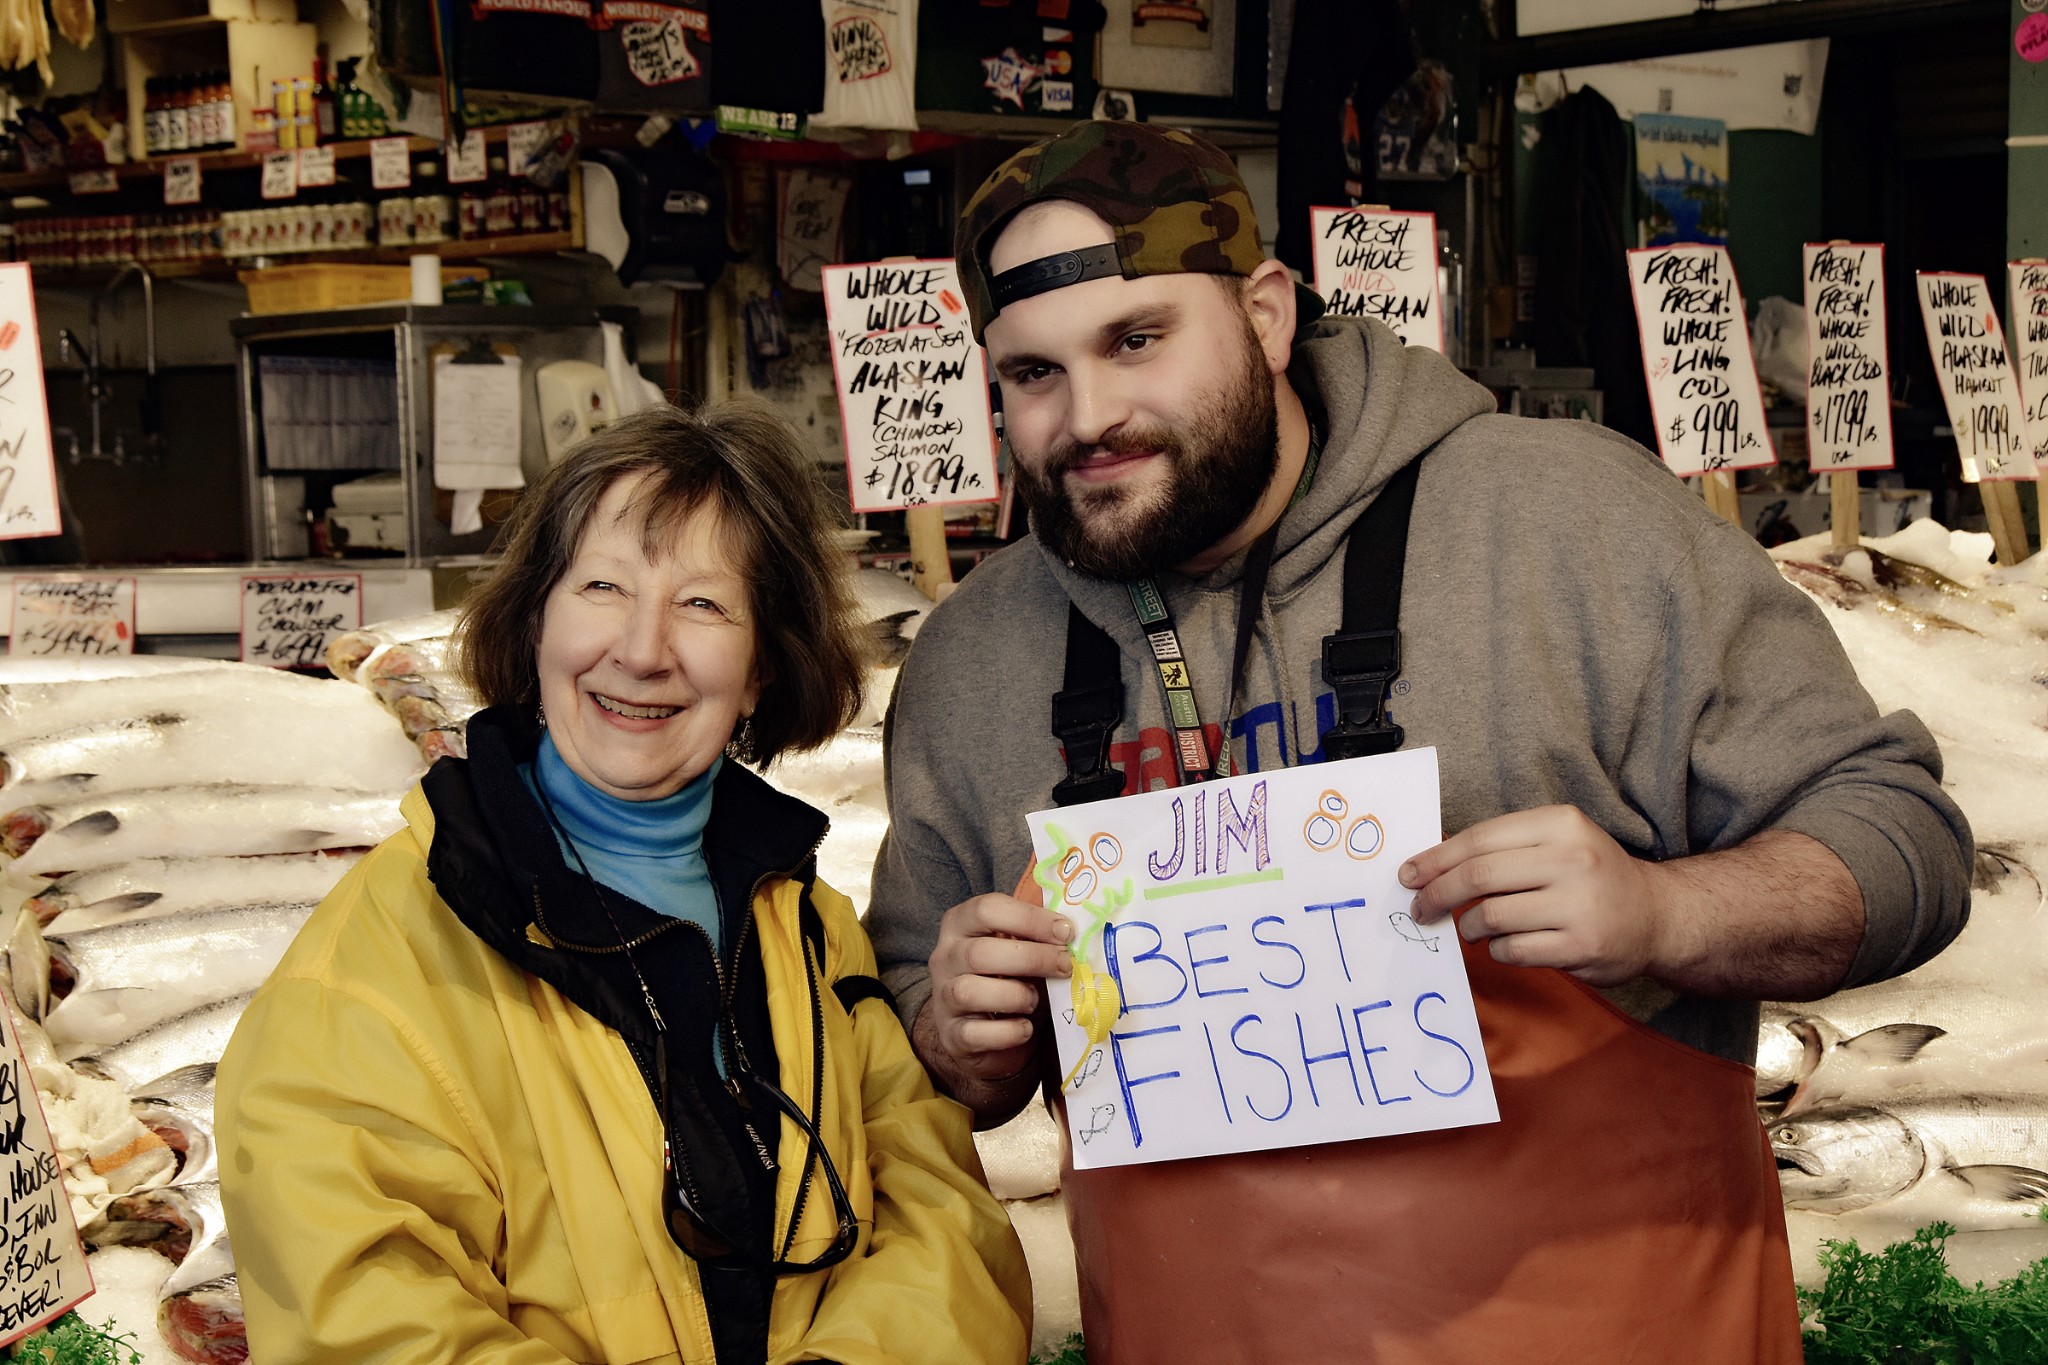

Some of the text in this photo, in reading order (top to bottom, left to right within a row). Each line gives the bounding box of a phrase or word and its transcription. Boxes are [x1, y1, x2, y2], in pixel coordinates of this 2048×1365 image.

[533, 0, 591, 16] FAMOUS
[605, 4, 651, 19] WORLD
[990, 63, 1021, 92] USA
[1046, 89, 1072, 101] VISA
[722, 107, 798, 131] WE ARE 12
[1378, 132, 1411, 172] 27
[1325, 211, 1410, 246] FRESH
[1336, 243, 1417, 271] WHOLE
[1643, 250, 1719, 286] FRESH!
[1810, 245, 1866, 287] FRESH!
[847, 265, 947, 299] WHOLE
[1342, 271, 1396, 292] WILD
[1660, 279, 1731, 316] FRESH!
[1927, 279, 1980, 309] WHOLE
[1325, 287, 1433, 324] ALASKAN
[1815, 280, 1875, 318] FRESH!
[866, 299, 941, 333] WILD
[1663, 317, 1733, 346] WHOLE
[1820, 318, 1873, 340] WHOLE
[1939, 313, 1986, 338] WILD
[910, 336, 932, 354] AT
[1672, 343, 1731, 375] LING
[1826, 341, 1862, 361] WILD
[1942, 341, 2006, 374] ALASKAN
[850, 346, 971, 393] ALASKAN
[1810, 353, 1882, 389] BLACK COD
[1679, 373, 1730, 400] COD
[873, 390, 944, 425] KING
[873, 417, 962, 444] (CHINOOK)
[871, 438, 954, 462] SALMON
[258, 597, 324, 617] CLAM
[1138, 577, 1164, 619] STREET
[257, 614, 348, 633] CHOWDER
[1181, 692, 1194, 725] Austin
[1178, 730, 1201, 769] DISTRICT
[1217, 739, 1231, 777] RED
[1148, 779, 1271, 882] JIM
[1102, 897, 1367, 1019] BEST
[1109, 991, 1476, 1149] FISHES
[10, 1151, 59, 1205] HOUSE
